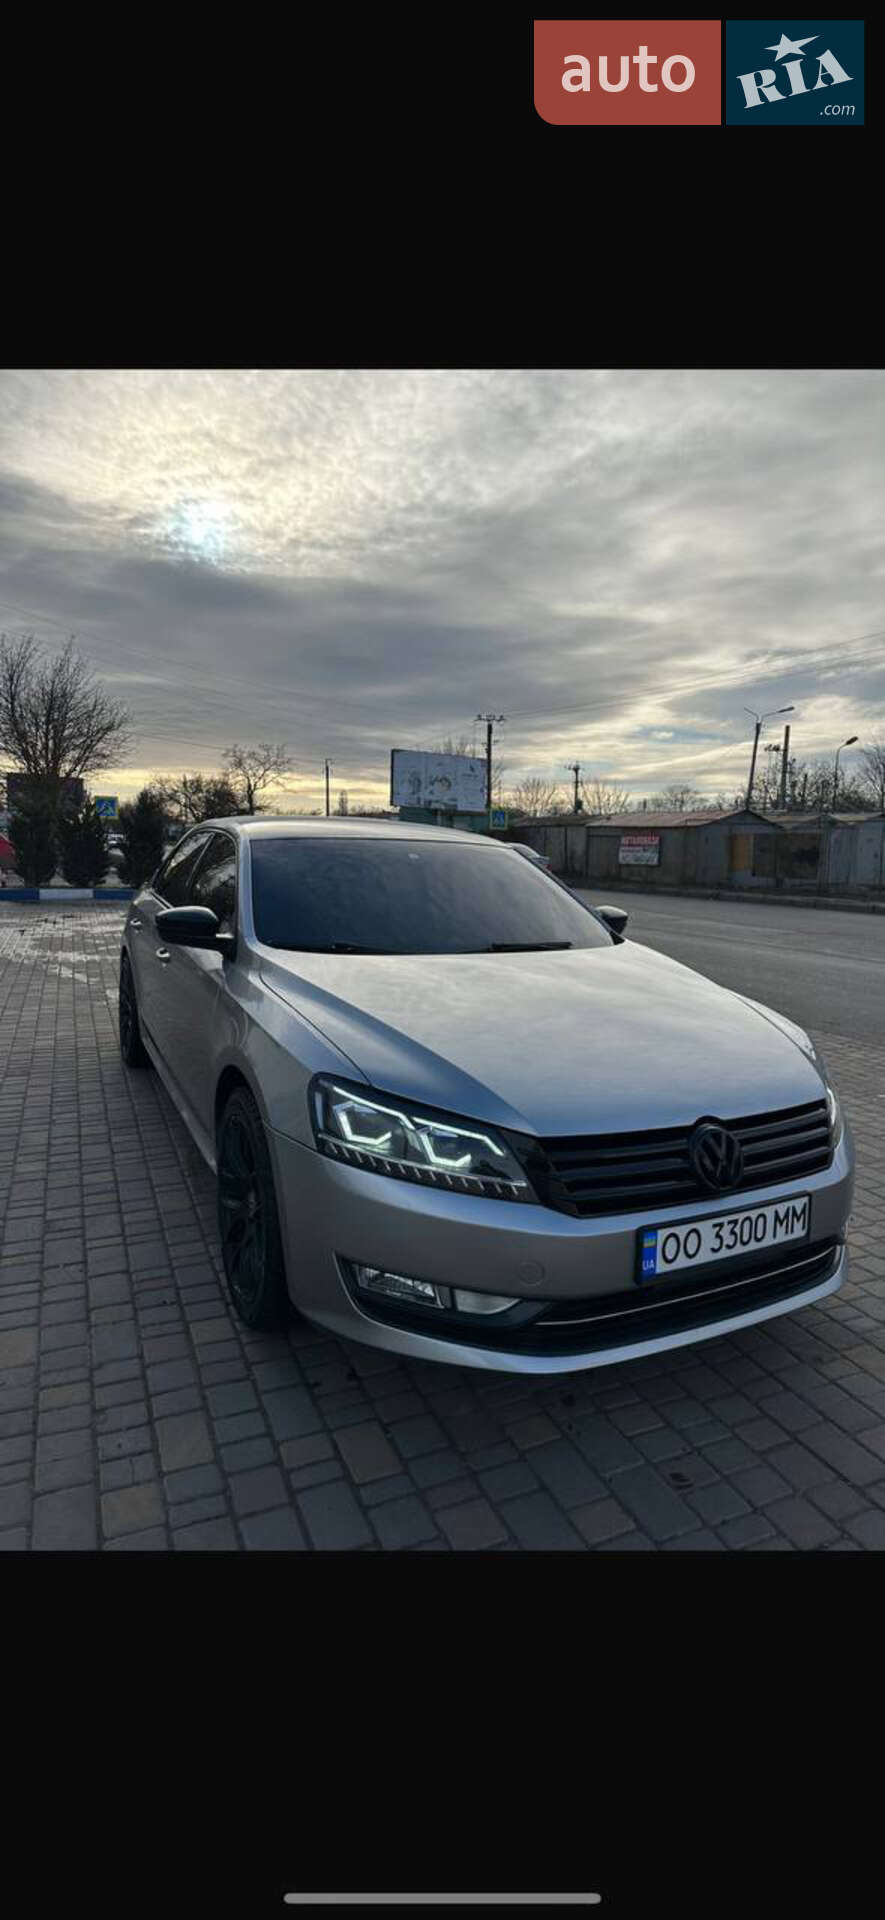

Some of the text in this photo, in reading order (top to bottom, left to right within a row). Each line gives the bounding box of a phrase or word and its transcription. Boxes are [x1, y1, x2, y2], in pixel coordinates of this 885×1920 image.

[661, 1202, 808, 1265] OO 3300 MM
[642, 1260, 655, 1271] UA
